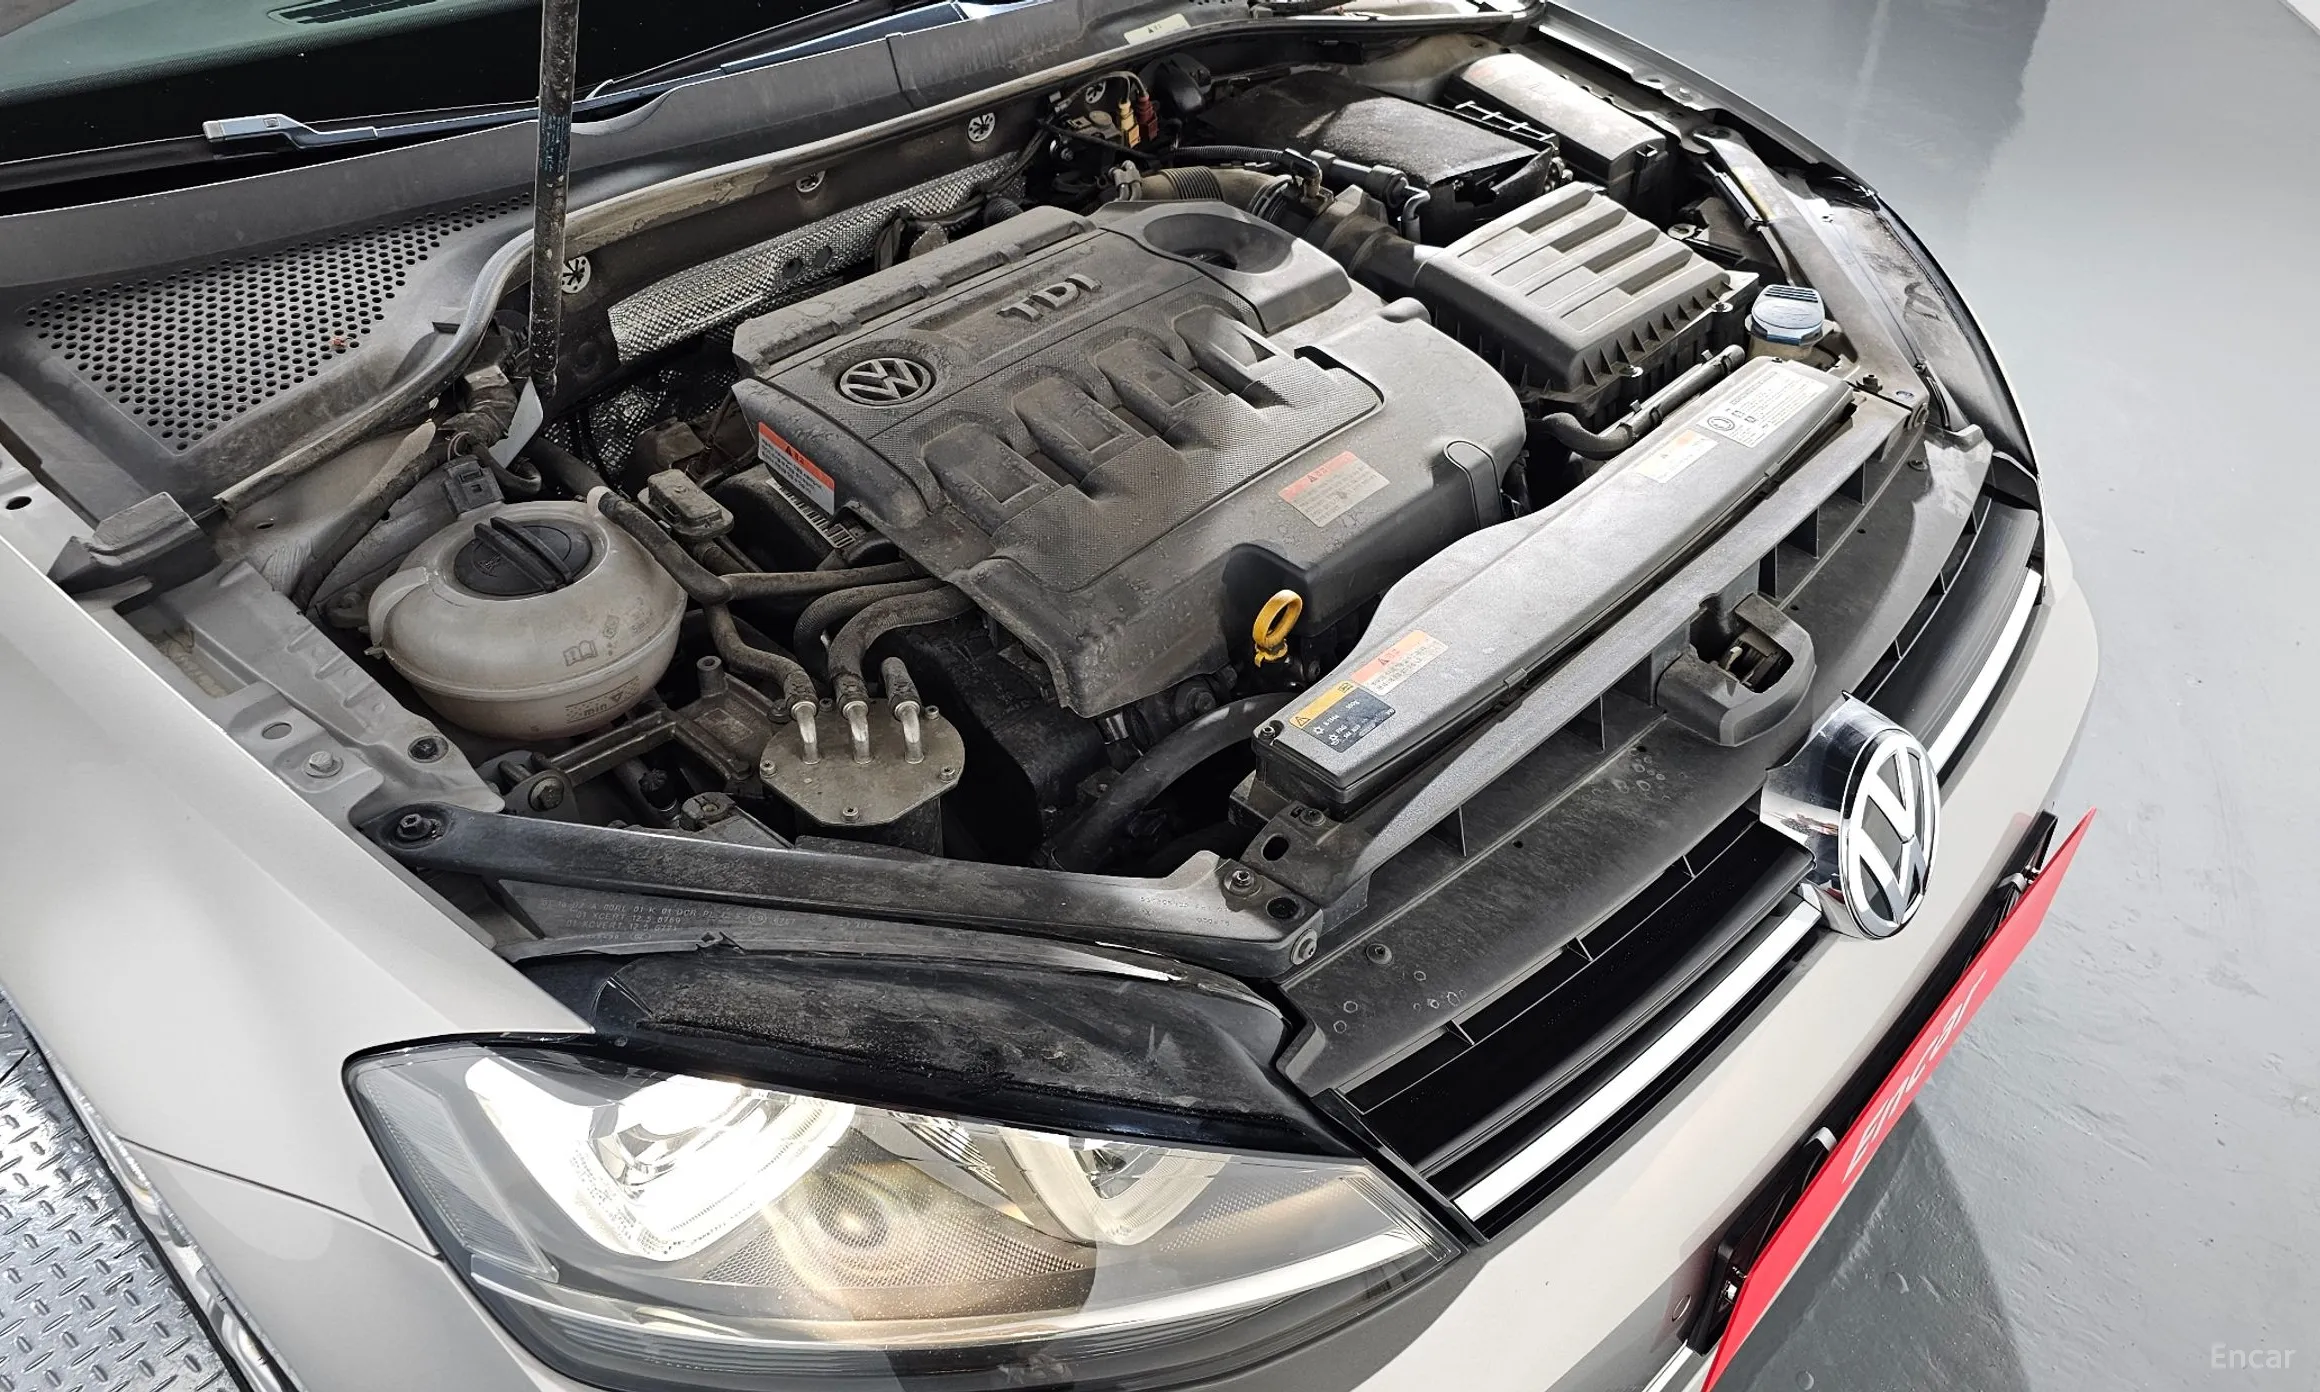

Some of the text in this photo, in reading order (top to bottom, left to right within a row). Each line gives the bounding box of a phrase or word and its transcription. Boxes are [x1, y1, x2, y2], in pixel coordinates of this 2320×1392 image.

[997, 273, 1103, 322] TDI
[583, 702, 608, 717] min
[1841, 969, 1988, 1184] Encar
